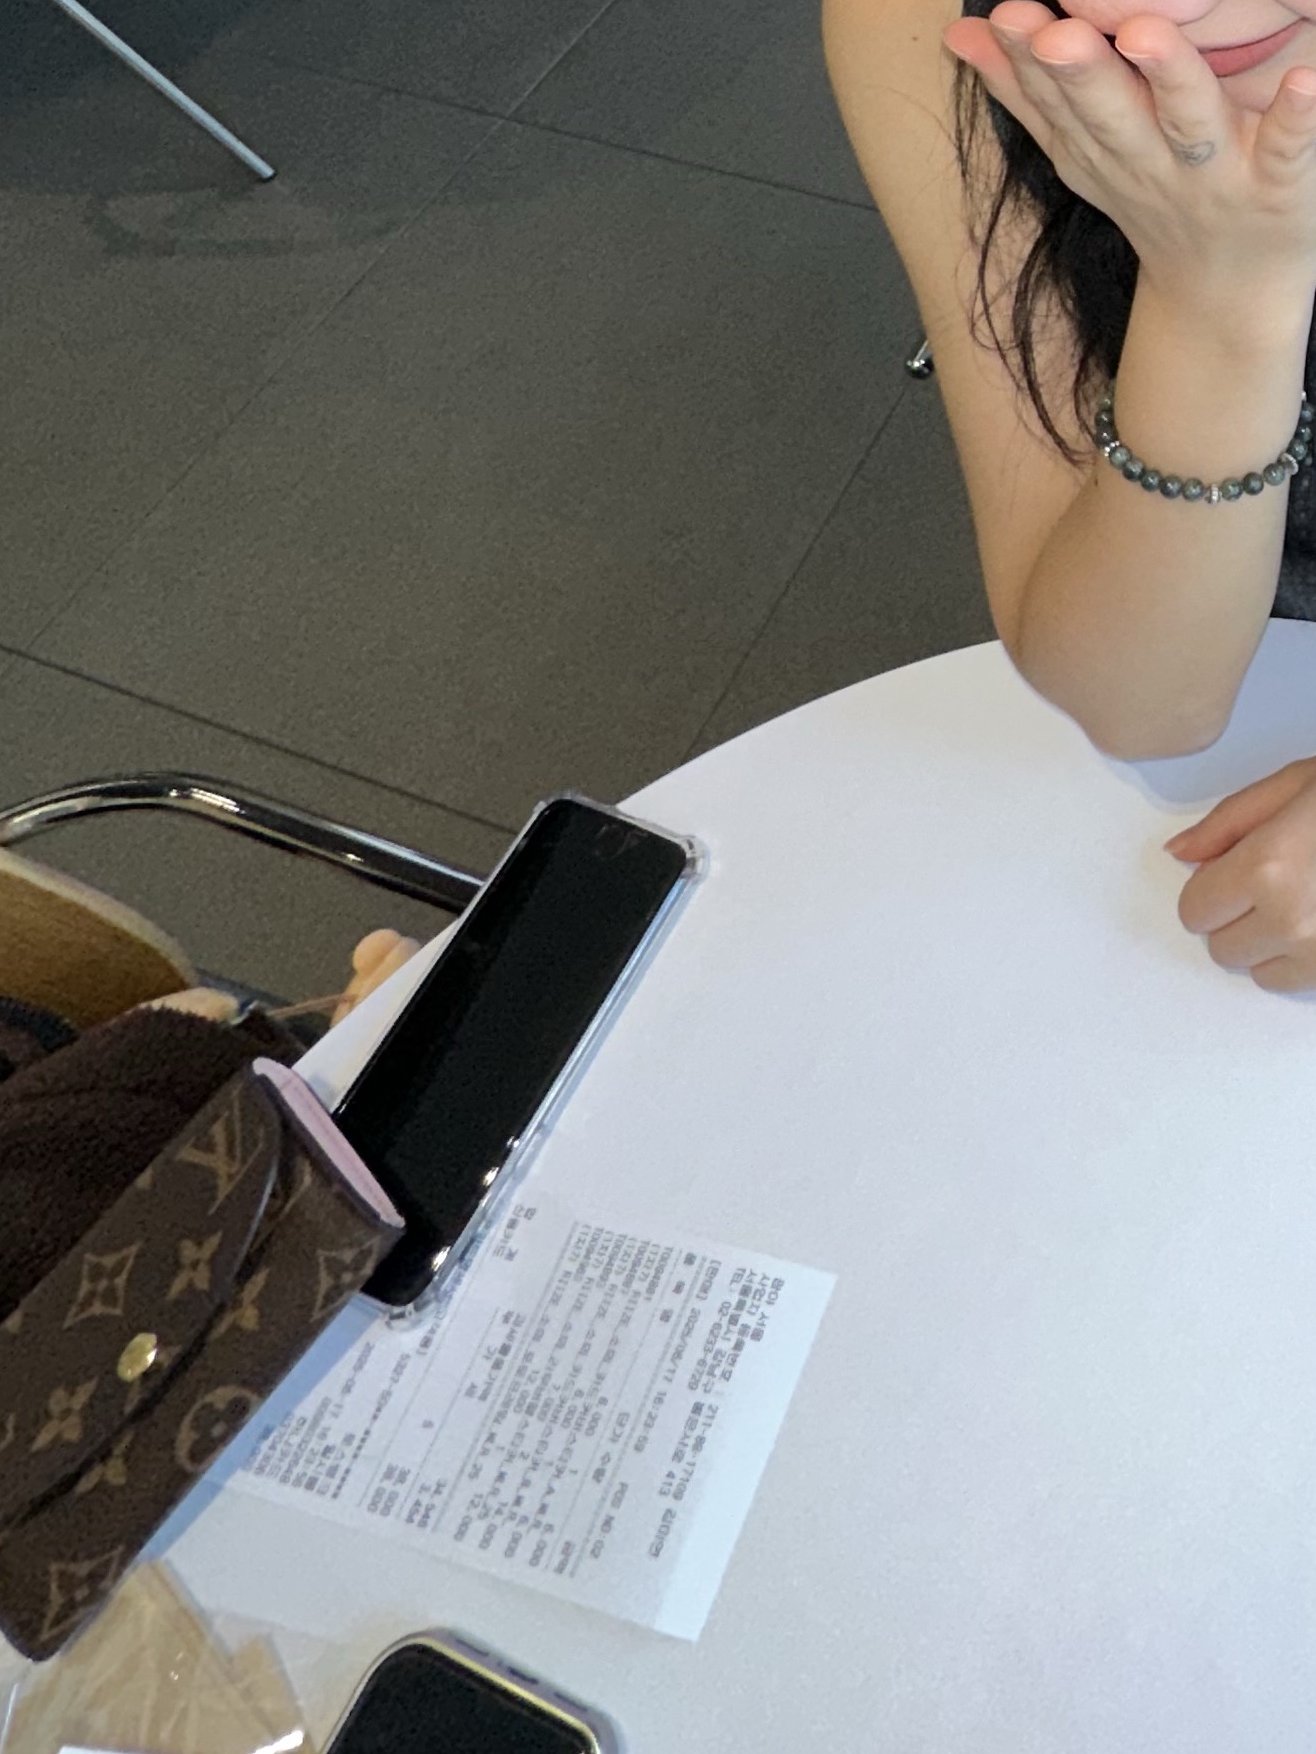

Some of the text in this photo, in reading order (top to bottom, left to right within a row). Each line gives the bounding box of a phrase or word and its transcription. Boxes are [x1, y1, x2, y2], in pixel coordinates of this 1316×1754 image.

[491, 1204, 526, 1258] 신용카드
[720, 1268, 759, 1342] 서울특별시
[745, 1272, 772, 1316] 사업자
[749, 1311, 771, 1342] 서울
[699, 1348, 727, 1394] 강남구
[718, 1322, 752, 1382] 등록번호
[607, 1410, 630, 1443] 단가
[590, 1450, 613, 1484] 수량
[657, 1469, 677, 1497] 413
